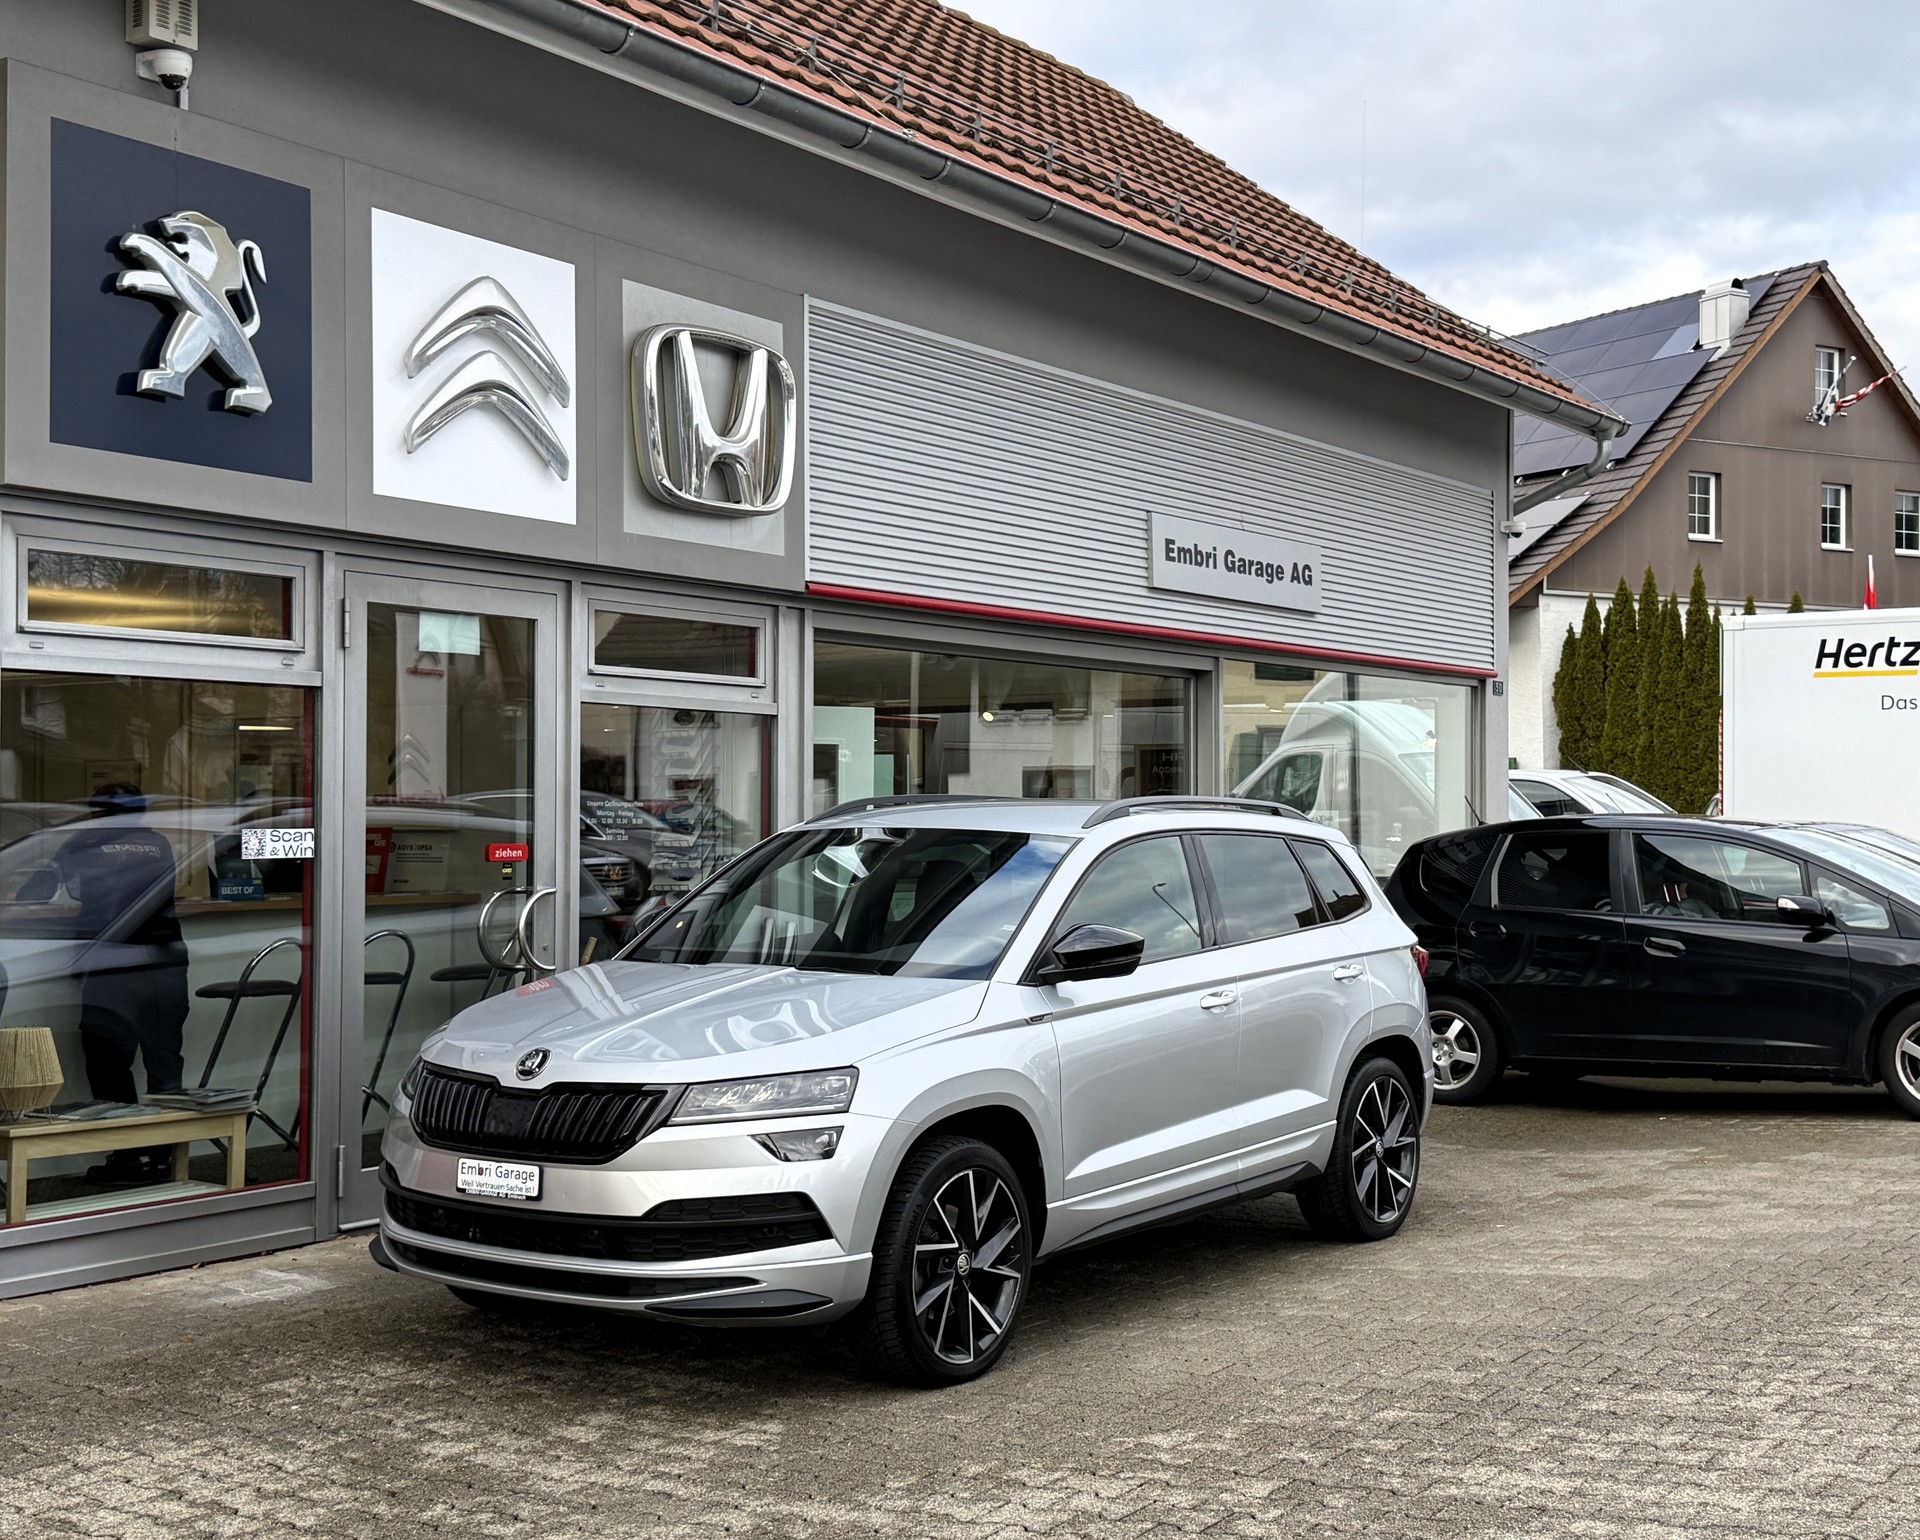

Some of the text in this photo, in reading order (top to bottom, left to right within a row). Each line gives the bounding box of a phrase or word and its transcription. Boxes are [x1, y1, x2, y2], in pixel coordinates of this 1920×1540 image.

[1164, 537, 1313, 587] Embri Garage AG
[1814, 636, 1920, 669] Hertz
[1880, 694, 1918, 711] Das
[618, 810, 634, 818] Freitag
[269, 829, 314, 843] Scan
[269, 843, 314, 857] & Win
[495, 848, 523, 858] ziehen
[221, 886, 254, 895] BEST OF
[460, 1161, 535, 1184] Embri Garage
[461, 1179, 474, 1188] Weil
[475, 1180, 505, 1191] Vertrauen
[506, 1183, 524, 1193] Sache
